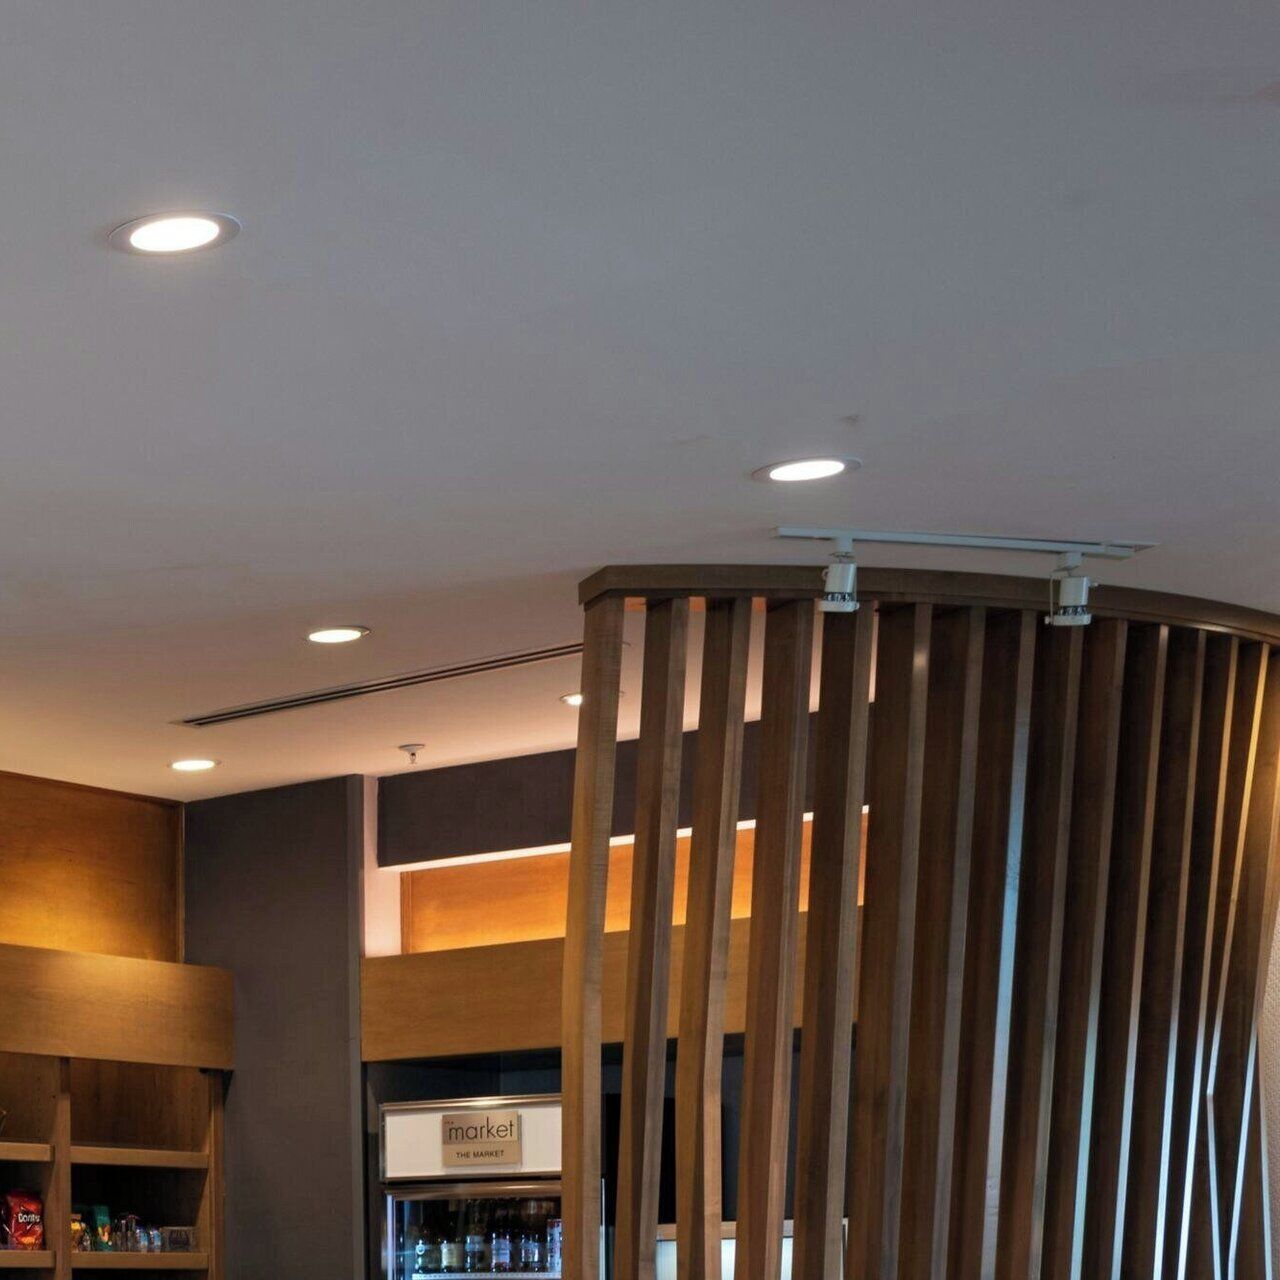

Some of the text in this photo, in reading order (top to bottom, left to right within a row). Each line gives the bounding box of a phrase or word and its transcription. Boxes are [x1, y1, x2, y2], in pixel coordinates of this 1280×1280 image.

[448, 1116, 514, 1141] market
[456, 1149, 504, 1159] THE MARKET
